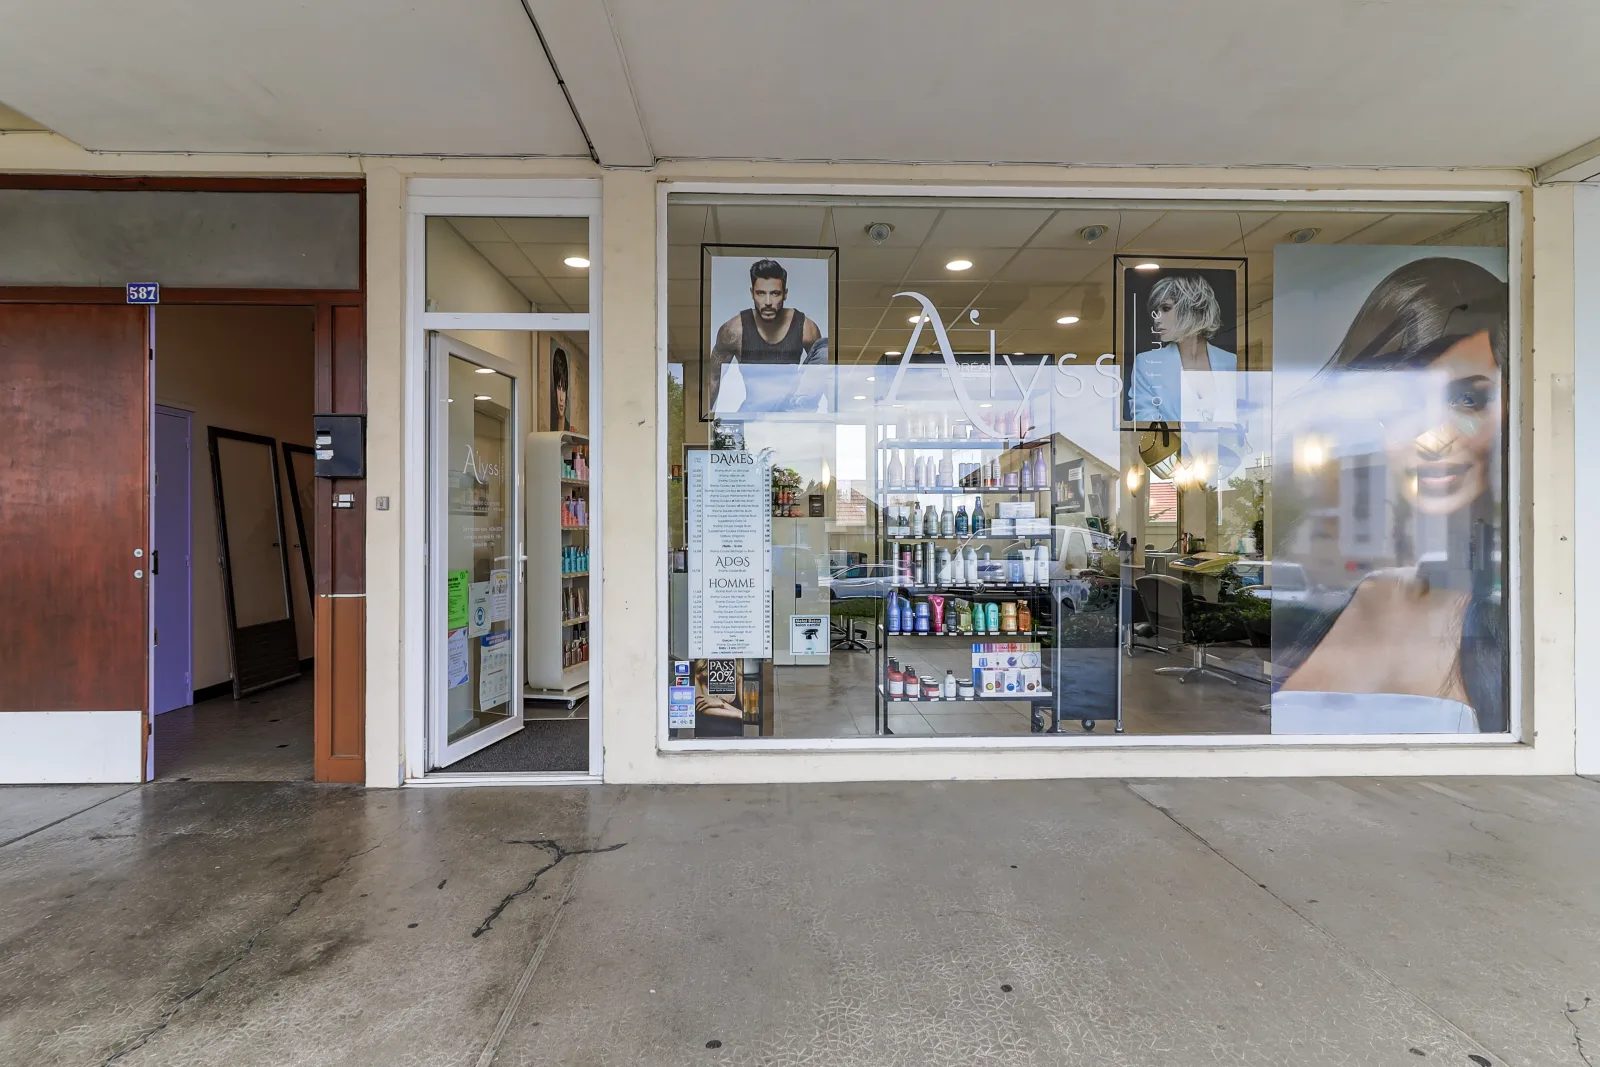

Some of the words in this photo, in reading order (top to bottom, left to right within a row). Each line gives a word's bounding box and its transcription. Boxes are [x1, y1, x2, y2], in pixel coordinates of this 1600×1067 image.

[129, 286, 156, 300] 587
[874, 291, 1123, 440] A'lyss
[1145, 310, 1163, 422] coiffure
[710, 452, 754, 467] DAMES
[715, 555, 750, 568] ADOS
[709, 578, 755, 588] HOMME
[710, 661, 734, 672] PASS
[710, 671, 734, 682] 20%
